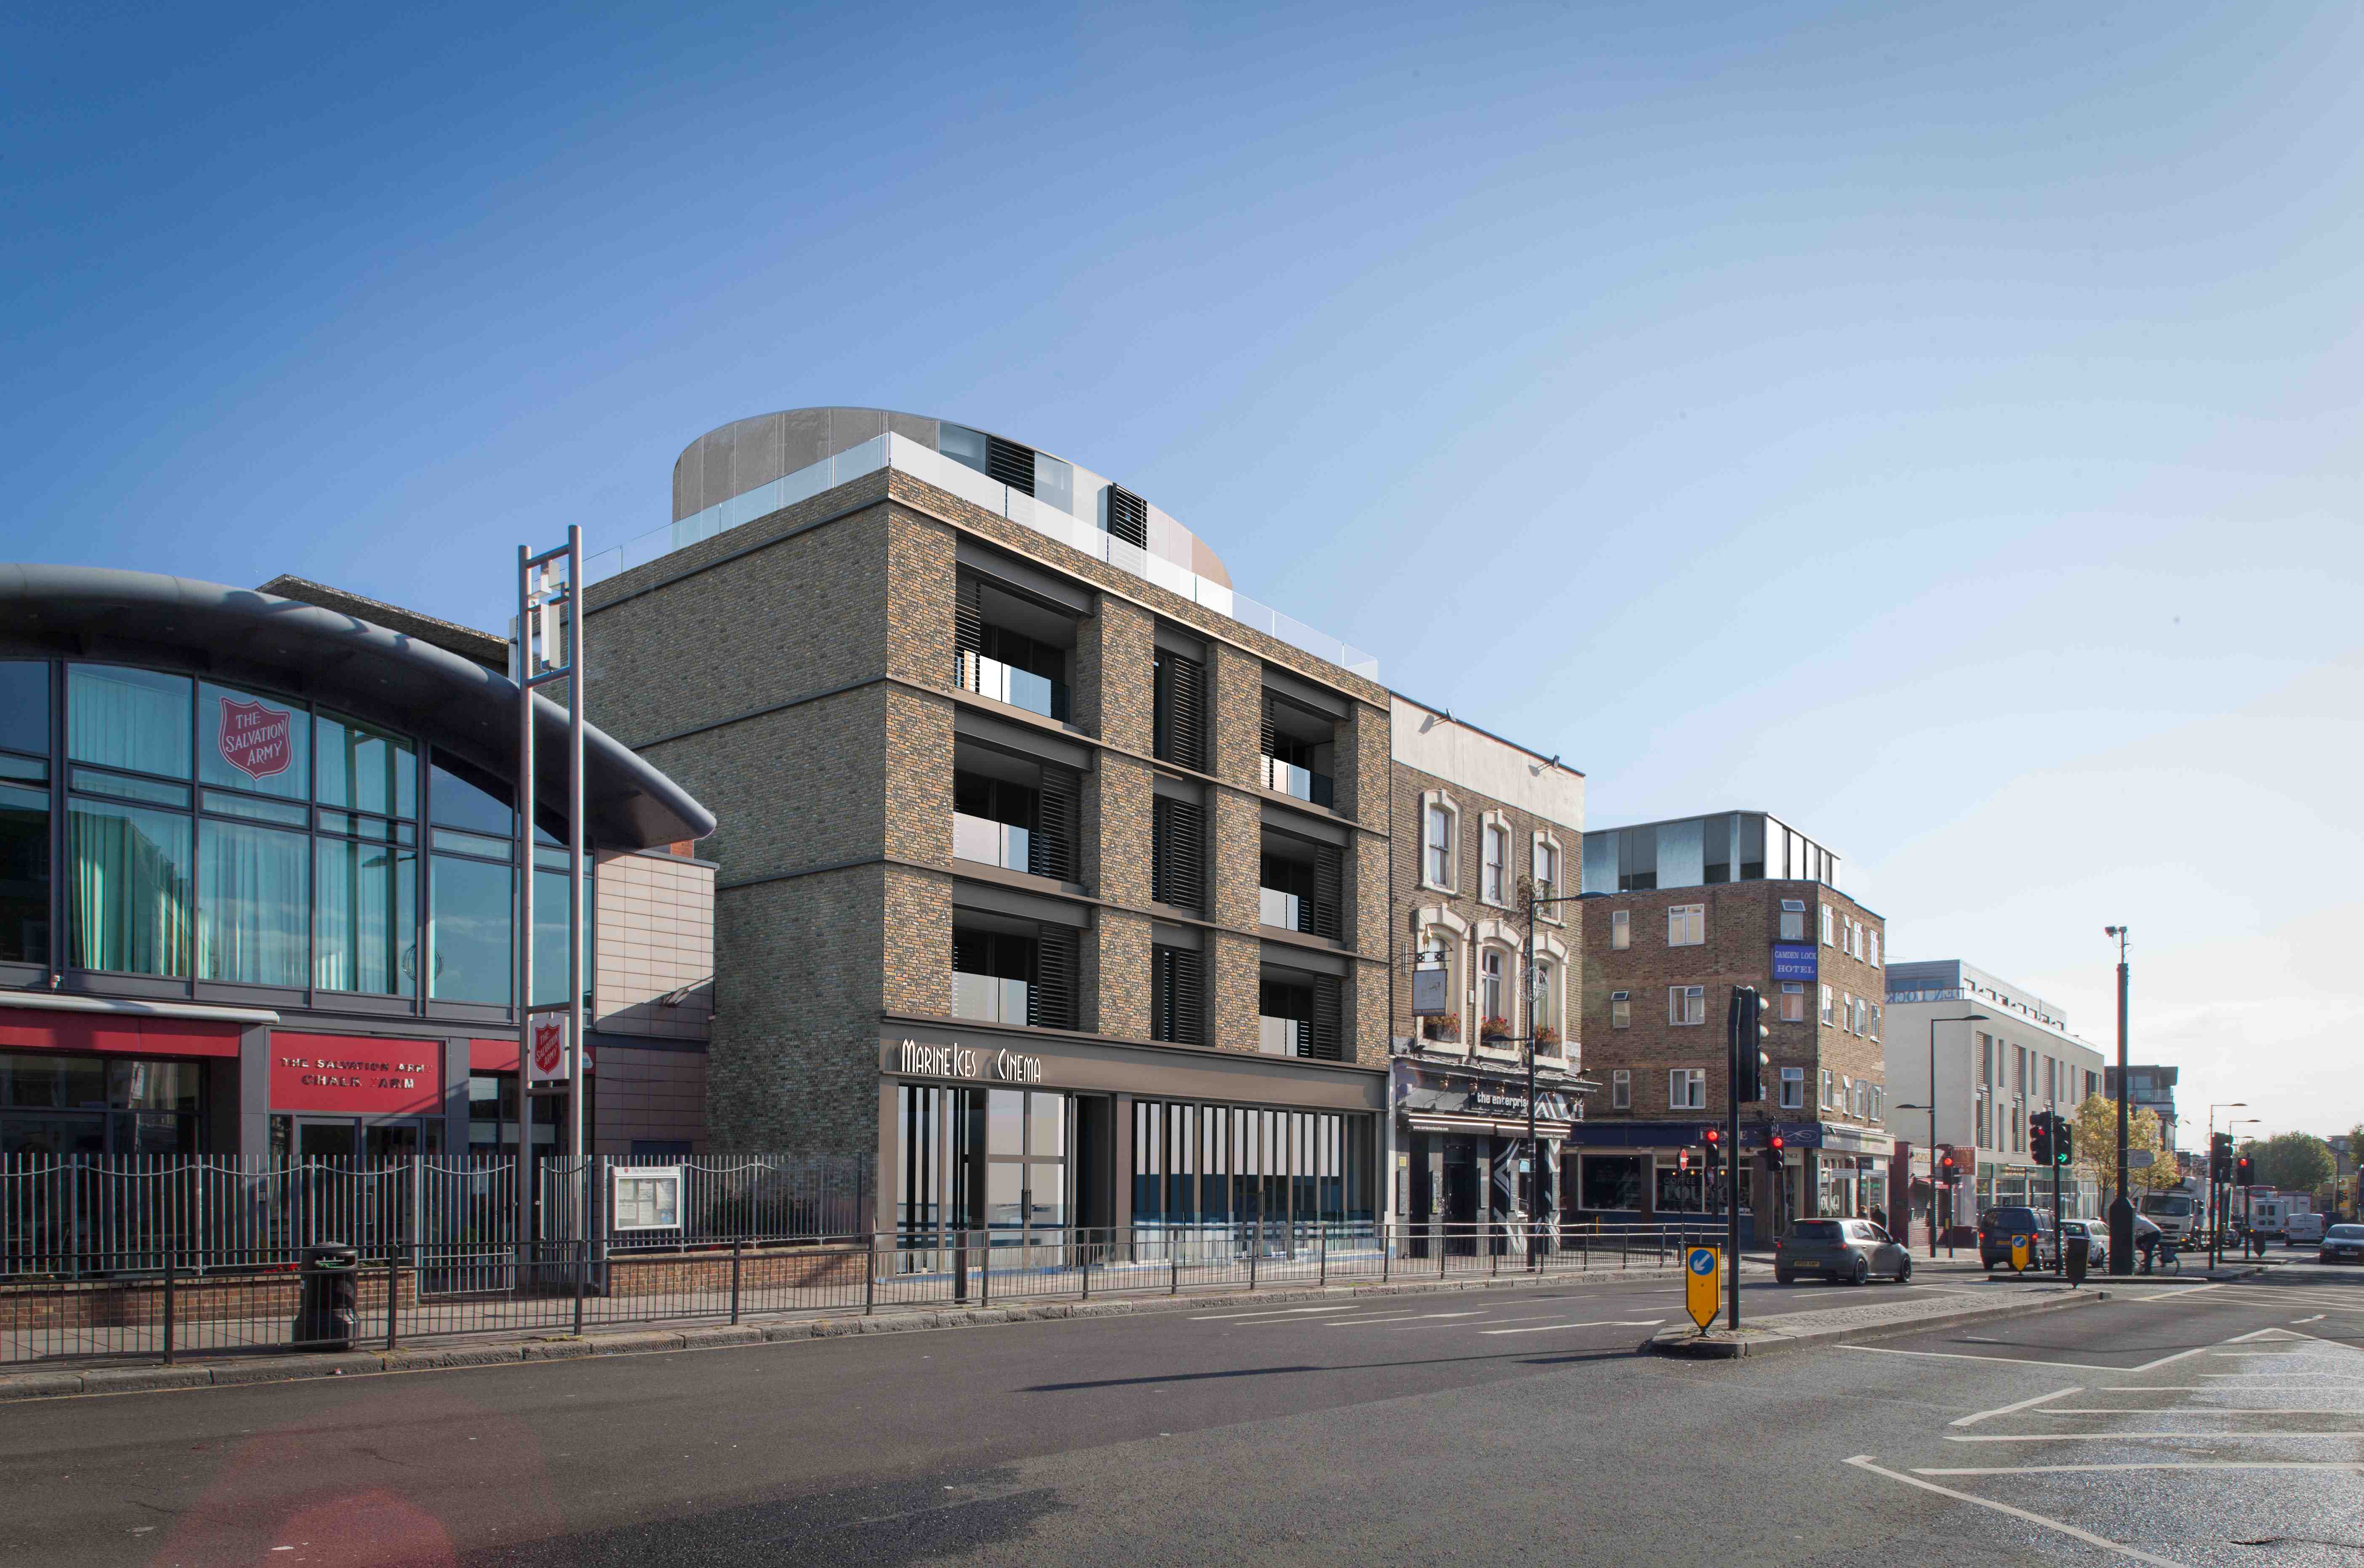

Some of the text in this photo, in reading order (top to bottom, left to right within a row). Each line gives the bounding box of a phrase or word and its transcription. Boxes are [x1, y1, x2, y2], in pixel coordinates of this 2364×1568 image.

[236, 712, 261, 729] THE
[226, 720, 285, 753] SALVATION
[247, 740, 282, 766] ARMY
[1777, 965, 1814, 973] HOTEL
[540, 1030, 550, 1045] THE
[536, 1031, 560, 1062] SALVATION
[280, 1057, 310, 1068] THE
[544, 1044, 557, 1068] ARMY
[902, 1038, 1041, 1083] MARINE ICES CINEMA
[302, 1074, 362, 1087] CHALK
[1477, 1091, 1491, 1104] the
